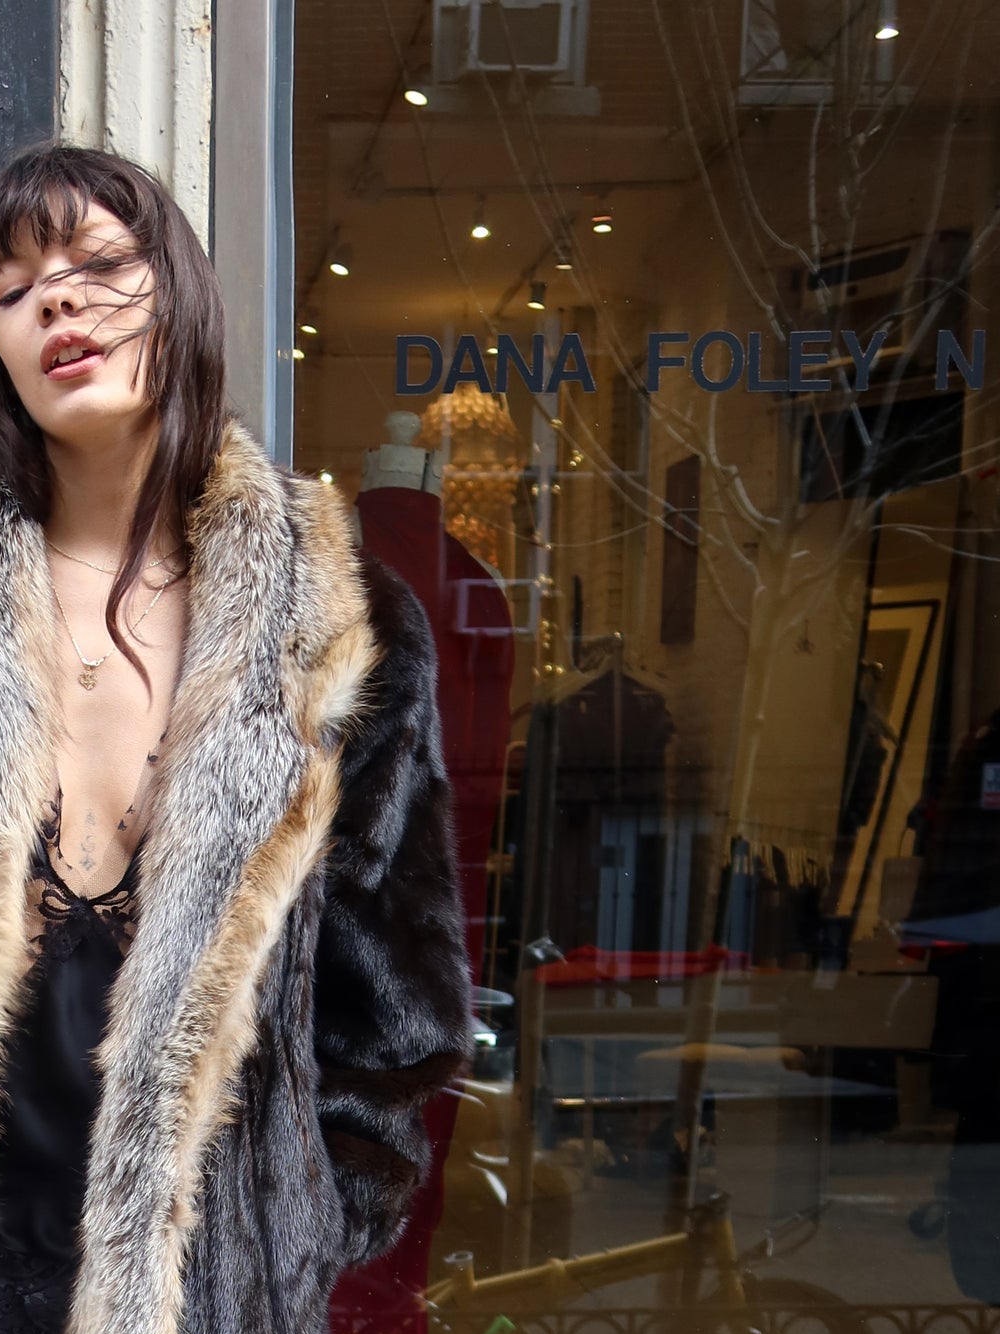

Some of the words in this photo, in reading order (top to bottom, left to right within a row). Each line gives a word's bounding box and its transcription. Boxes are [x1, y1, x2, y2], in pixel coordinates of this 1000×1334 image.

[395, 333, 596, 396] DANA
[647, 329, 888, 393] FOLEY
[934, 329, 986, 392] N
